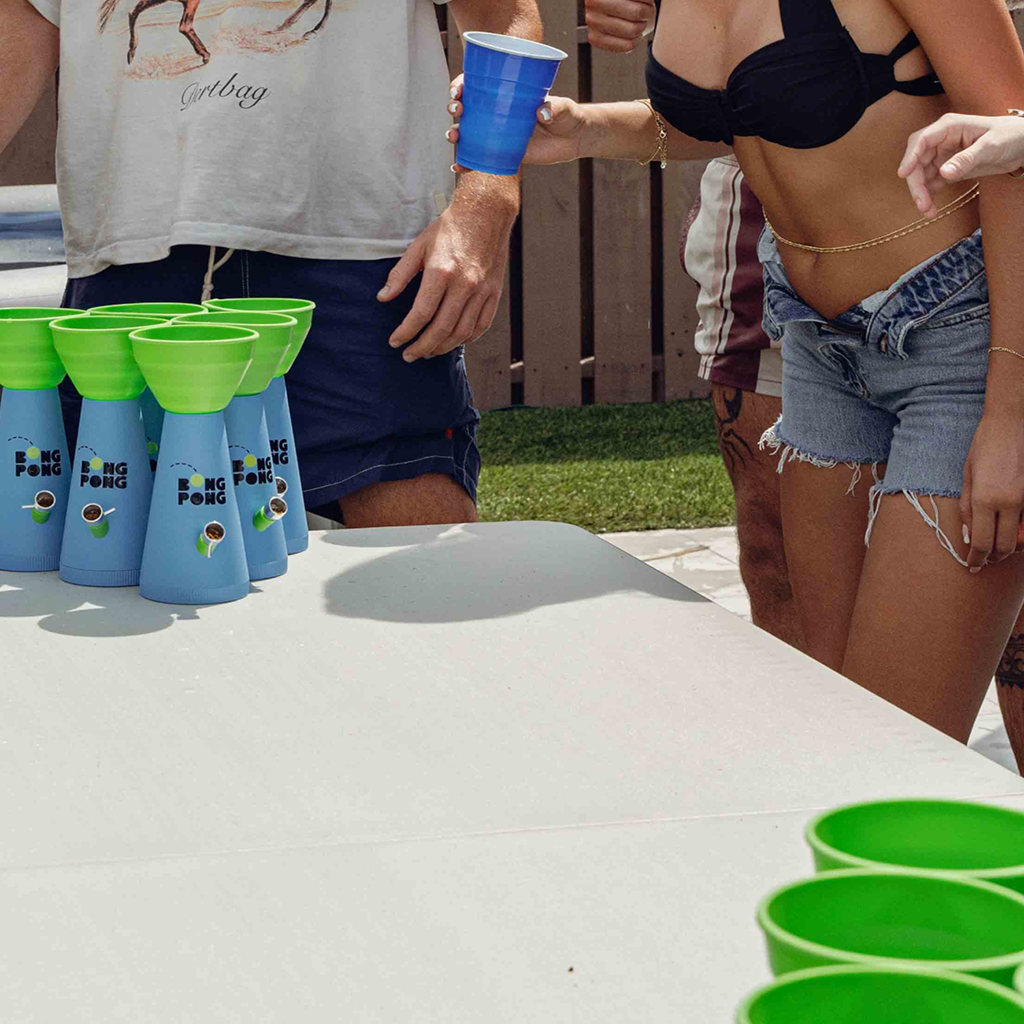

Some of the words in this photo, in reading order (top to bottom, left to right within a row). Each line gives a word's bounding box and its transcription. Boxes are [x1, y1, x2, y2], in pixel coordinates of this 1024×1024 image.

[269, 438, 288, 452] NG
[15, 446, 61, 464] BONG
[232, 454, 272, 473] BONG
[15, 463, 62, 477] PONG
[81, 457, 128, 476] BONG
[80, 474, 128, 490] PONG
[178, 473, 226, 491] BONG
[233, 470, 274, 487] PONG
[178, 491, 227, 506] PONG
